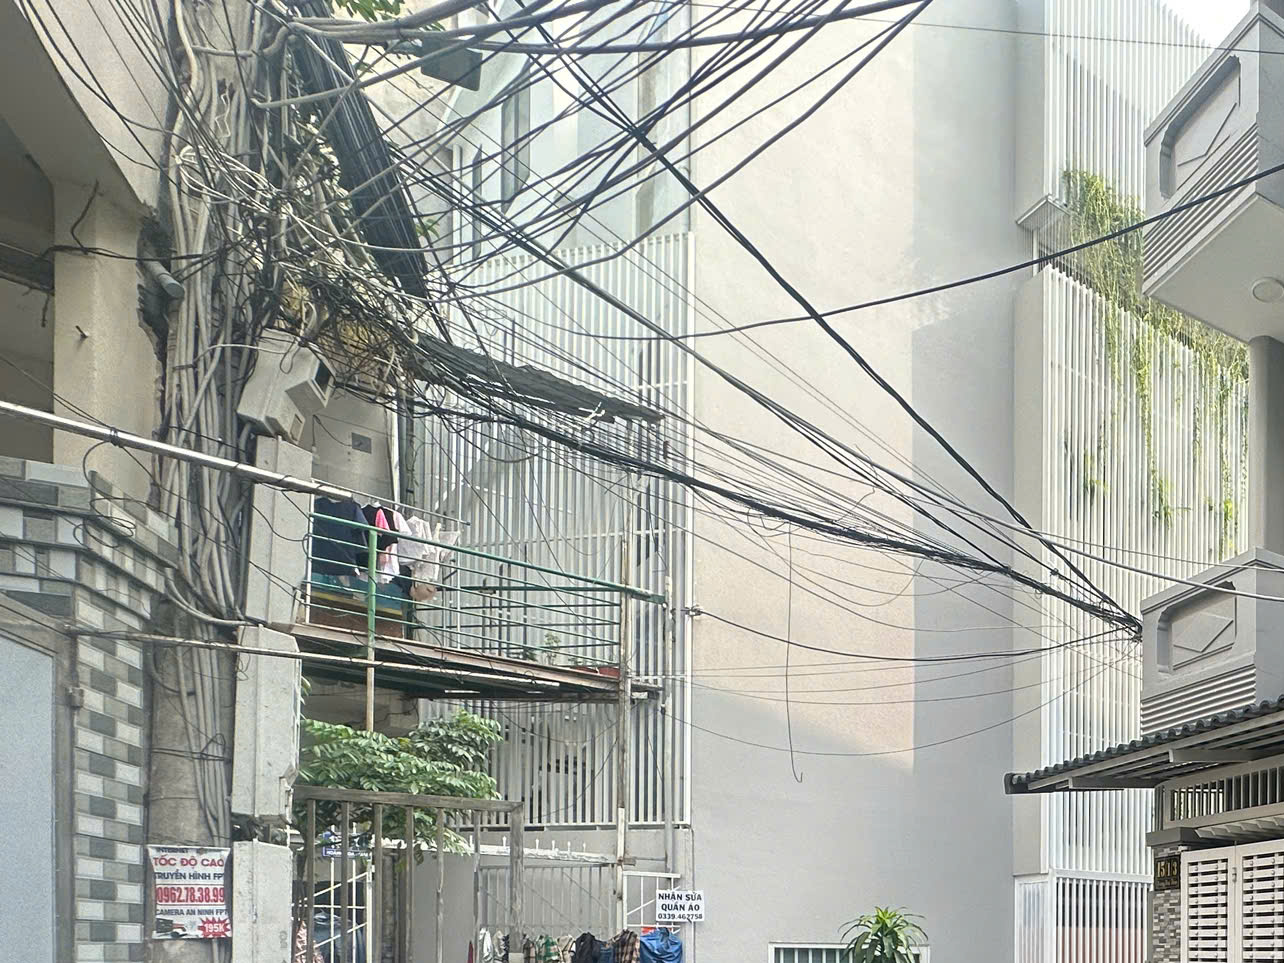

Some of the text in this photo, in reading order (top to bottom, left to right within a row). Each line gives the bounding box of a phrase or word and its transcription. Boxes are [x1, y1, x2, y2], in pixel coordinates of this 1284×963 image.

[153, 854, 224, 869] TỐC ĐỘ CAO
[189, 871, 211, 880] HÌNH
[186, 908, 196, 916] AN
[204, 923, 225, 932] 195K
